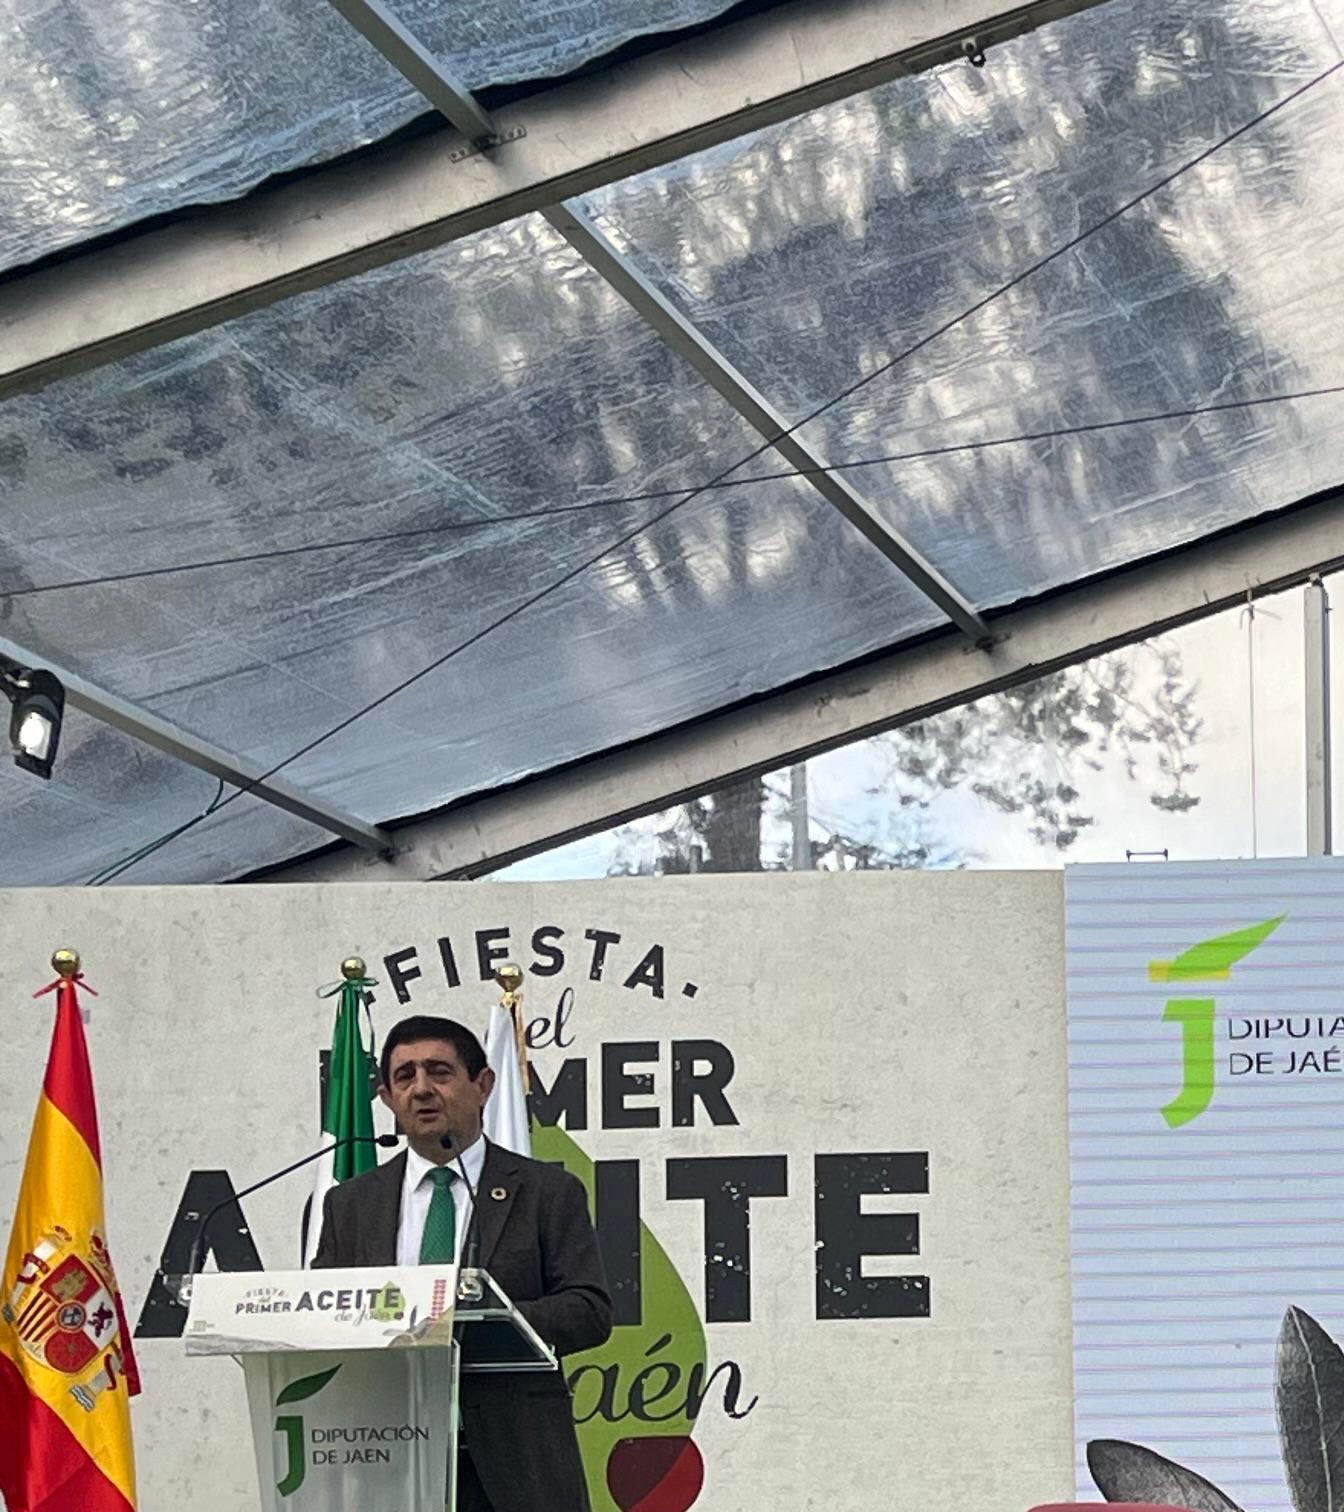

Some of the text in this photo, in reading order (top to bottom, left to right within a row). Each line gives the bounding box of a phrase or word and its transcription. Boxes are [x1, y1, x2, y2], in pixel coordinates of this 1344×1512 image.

[1229, 1052, 1274, 1075] DE
[135, 1149, 932, 1339] AITE
[235, 1287, 402, 1315] PRIMER ACEITE
[566, 1334, 758, 1425] aén
[311, 1424, 430, 1444] DIPUTACIÓN
[312, 1449, 338, 1465] DE
